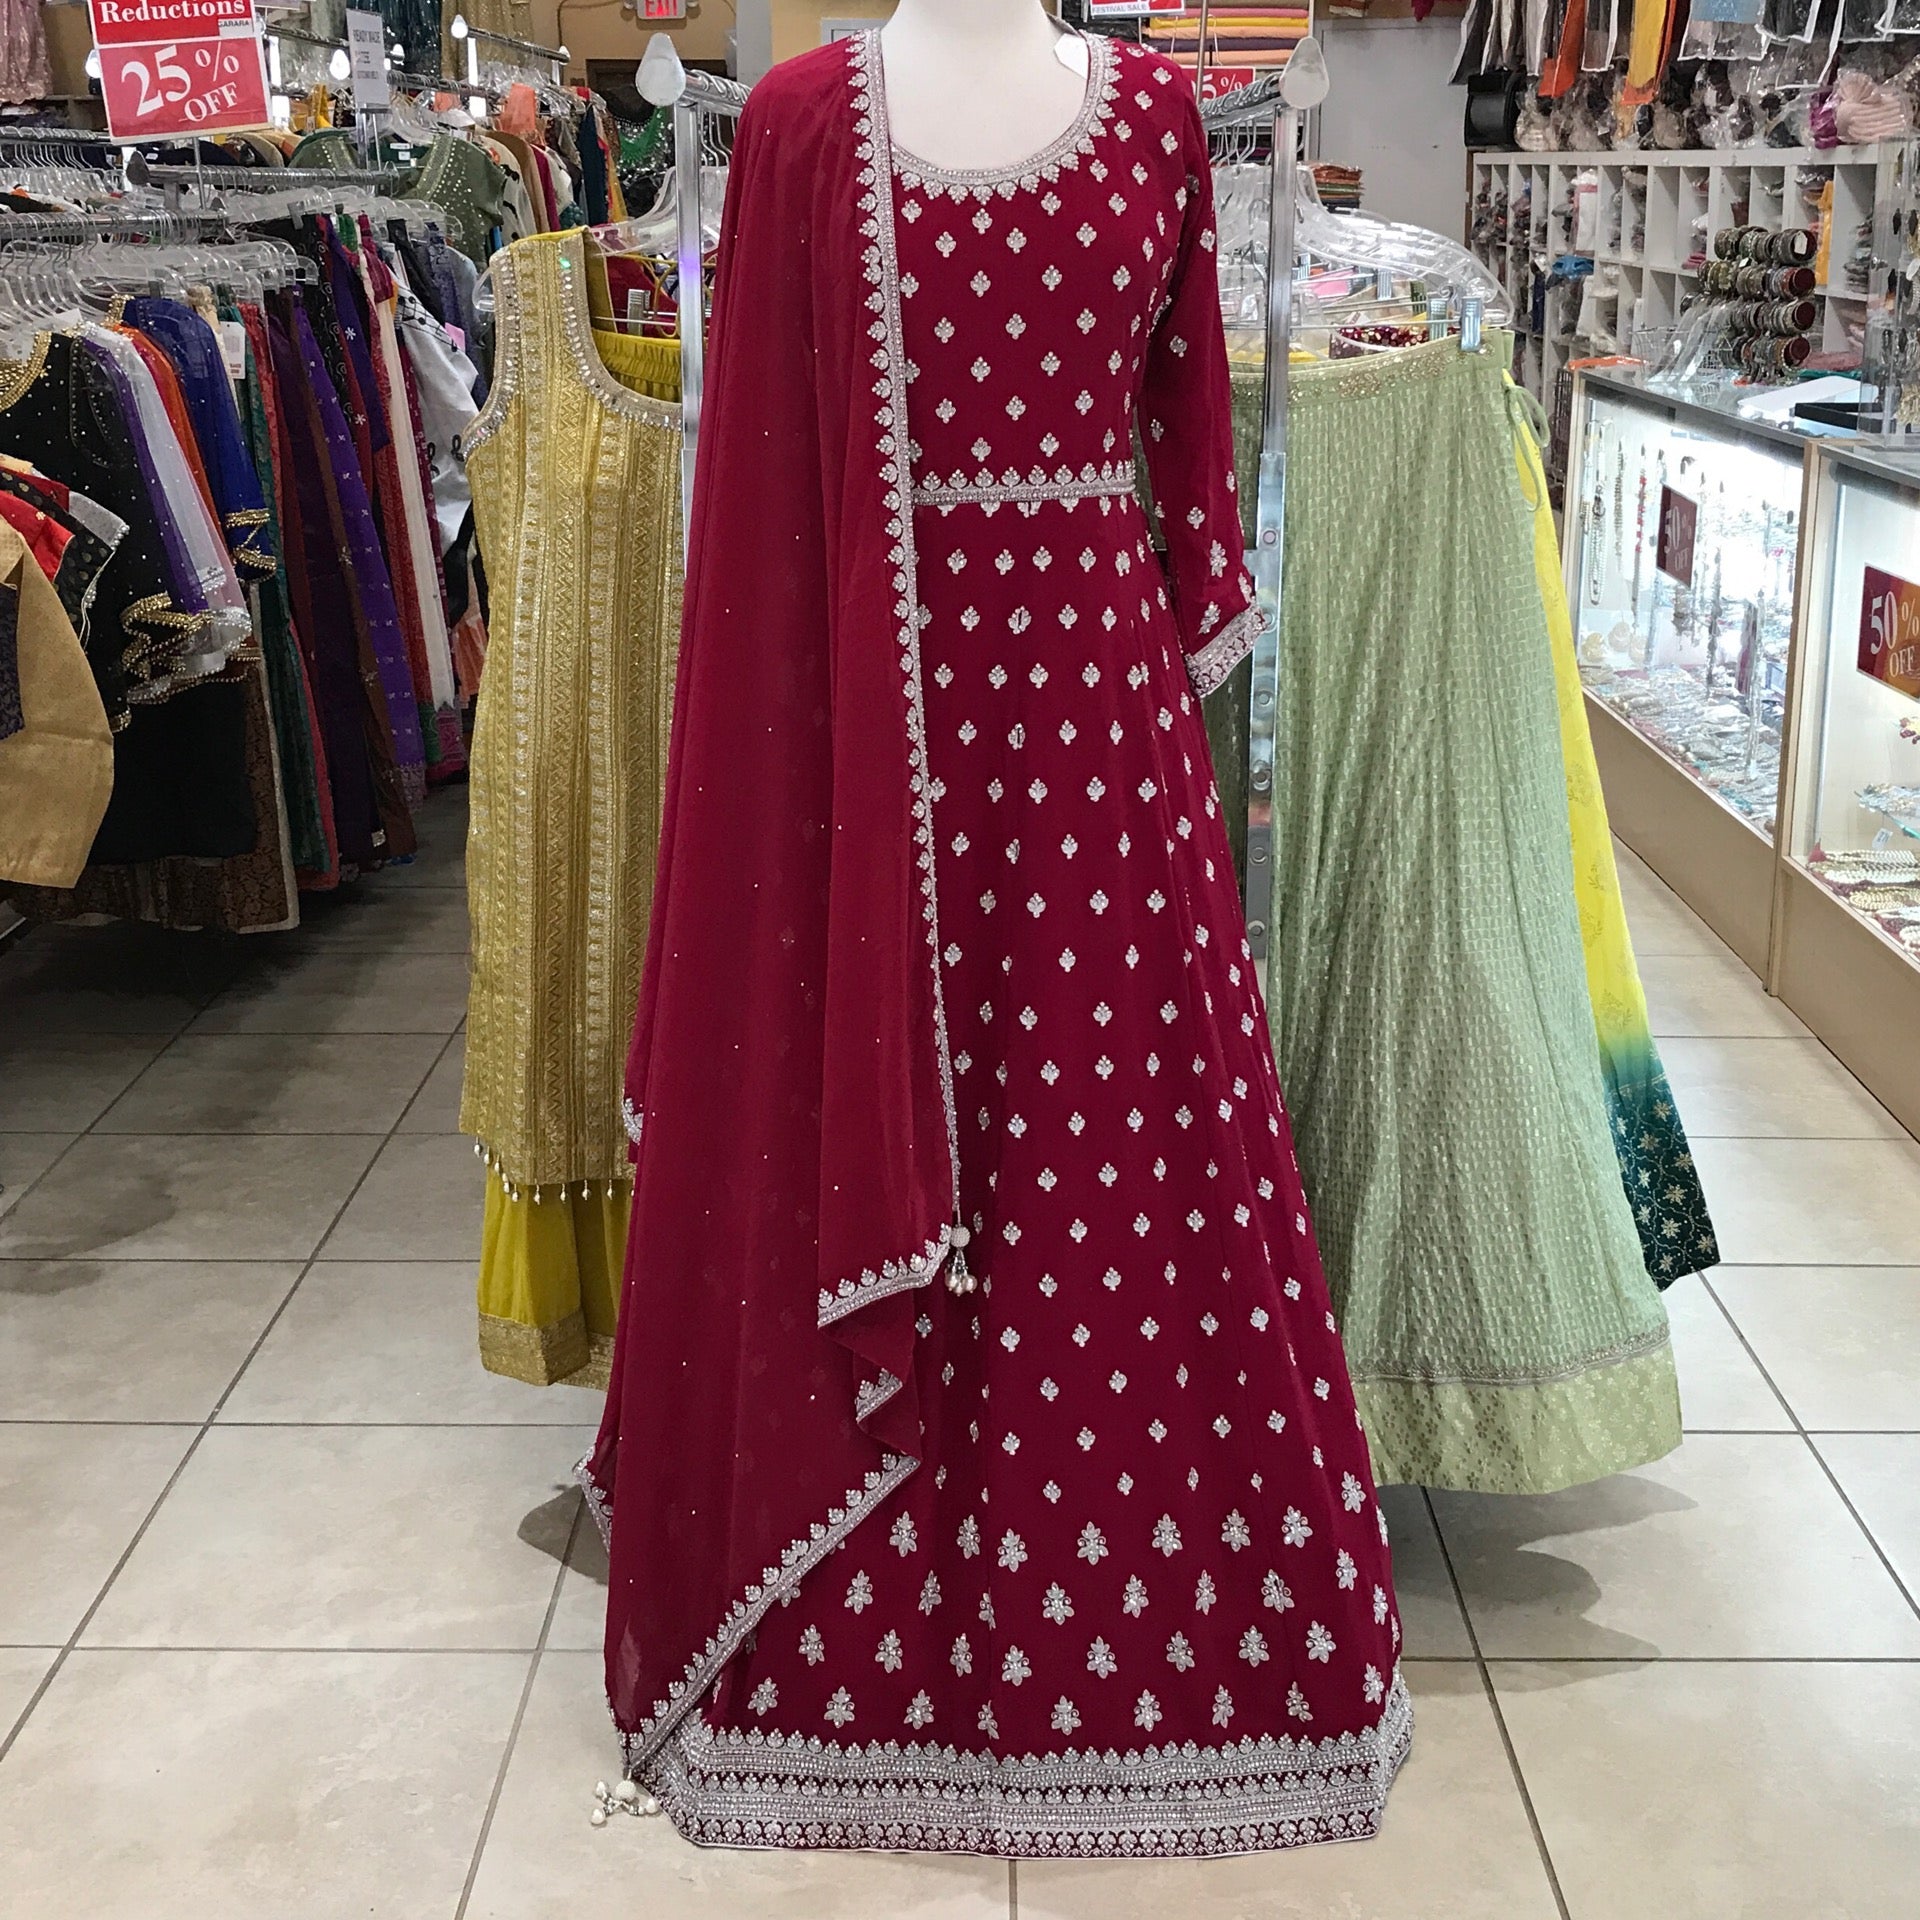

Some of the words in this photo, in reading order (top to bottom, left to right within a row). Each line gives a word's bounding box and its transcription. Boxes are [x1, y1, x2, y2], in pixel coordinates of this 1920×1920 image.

[100, 0, 246, 24] Reductions
[1092, 5, 1125, 14] FESTIVAL
[1127, 3, 1147, 11] SALE
[184, 82, 238, 122] OFF
[1675, 548, 1689, 572] OFF
[1889, 645, 1915, 678] OFF
